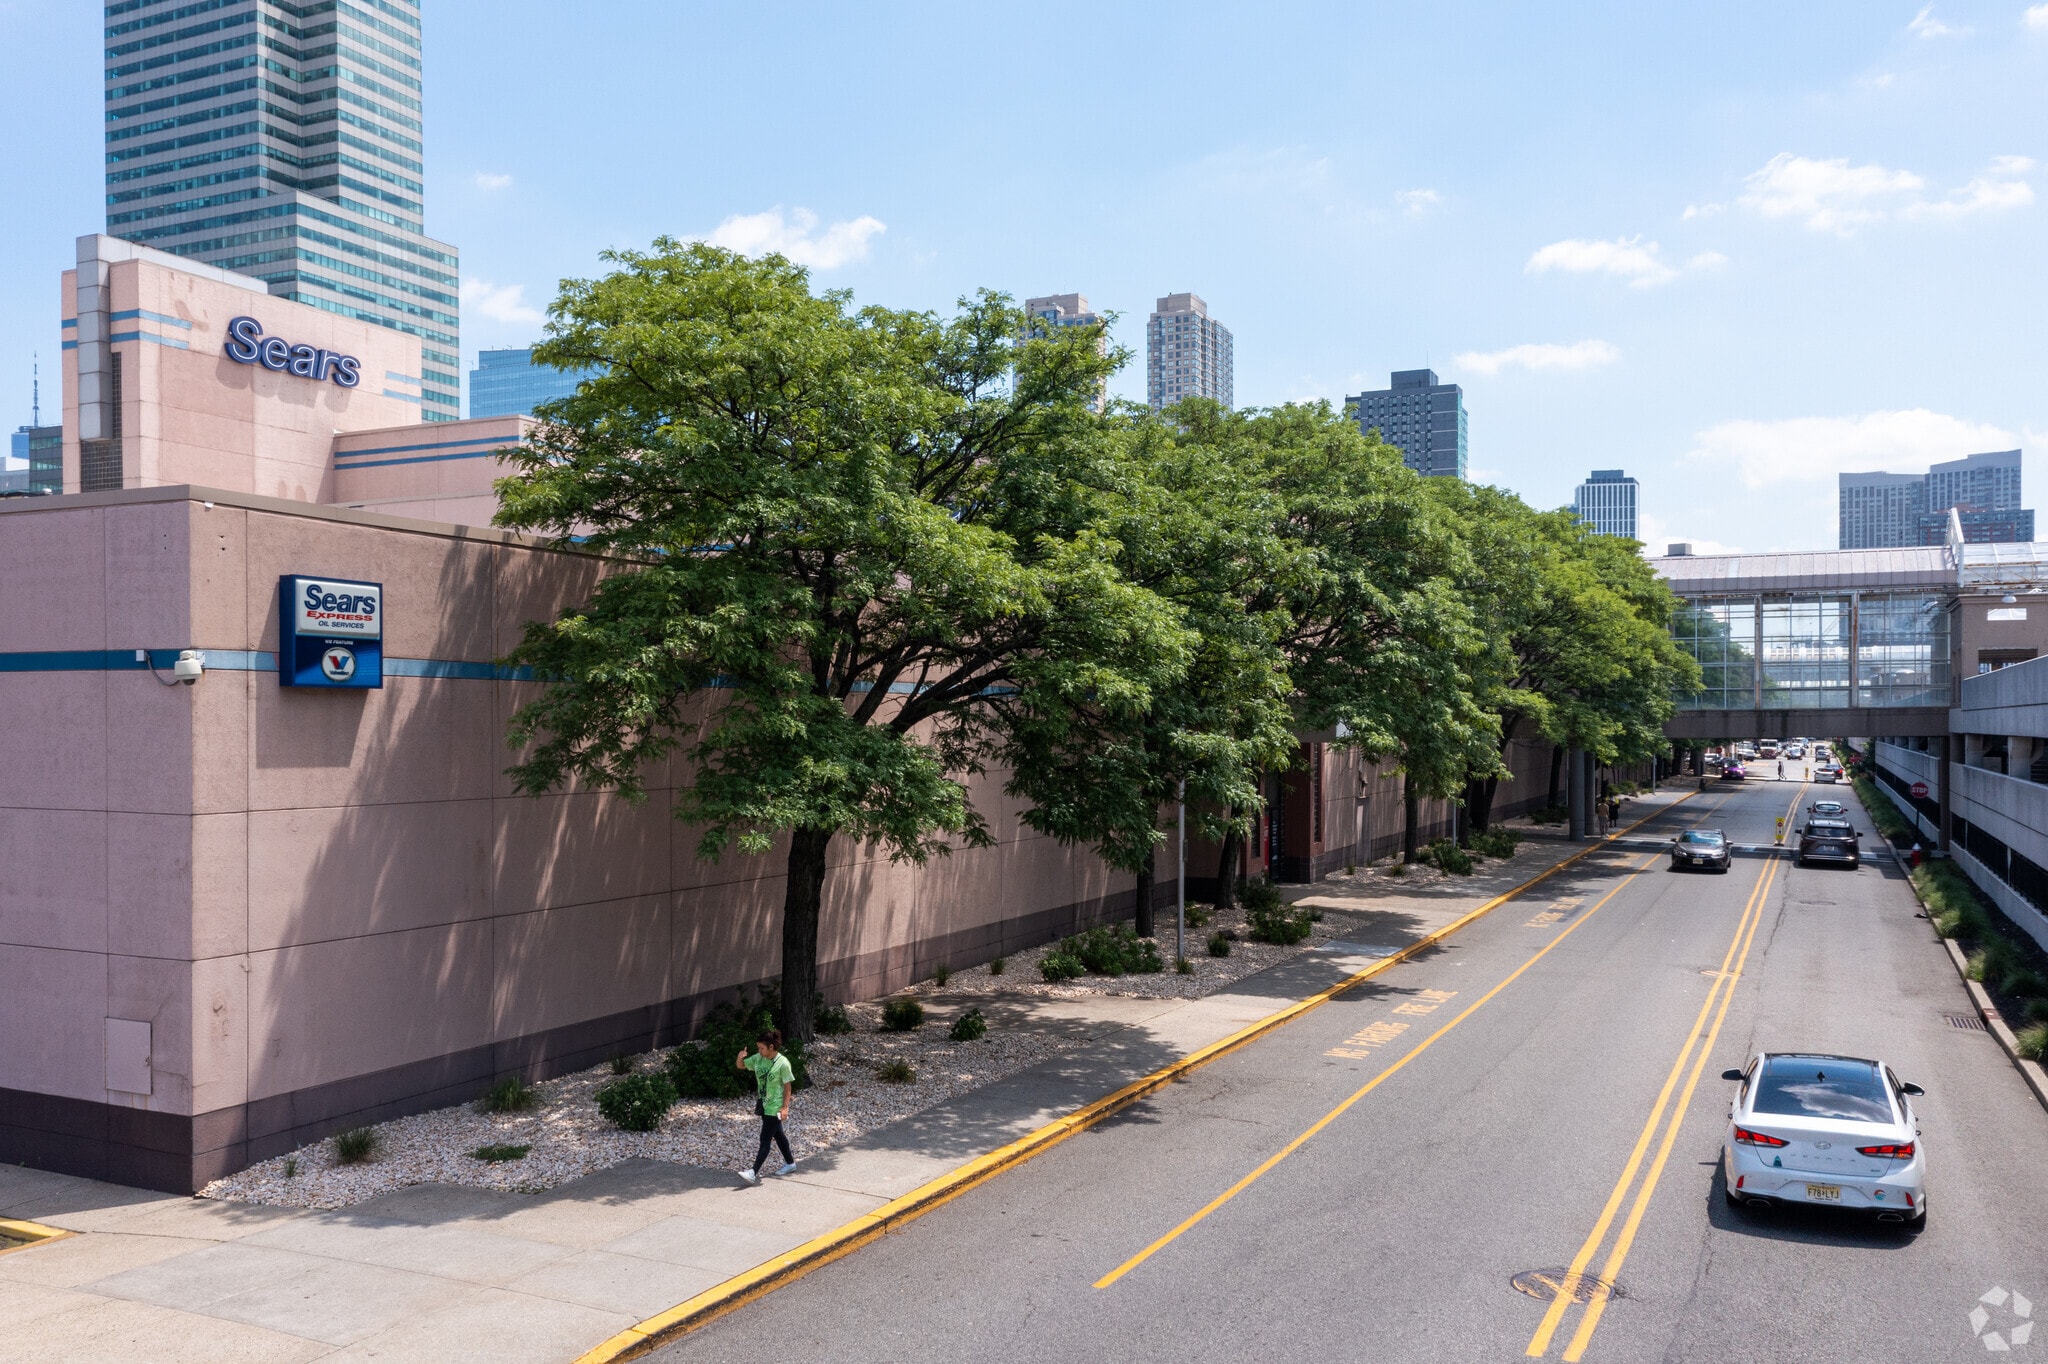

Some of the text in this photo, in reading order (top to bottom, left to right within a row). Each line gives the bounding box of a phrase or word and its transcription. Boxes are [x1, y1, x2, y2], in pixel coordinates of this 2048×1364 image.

[225, 316, 361, 388] Sears
[304, 584, 376, 614] Sears
[306, 610, 373, 621] EXPRESS
[331, 621, 365, 629] SERVICES
